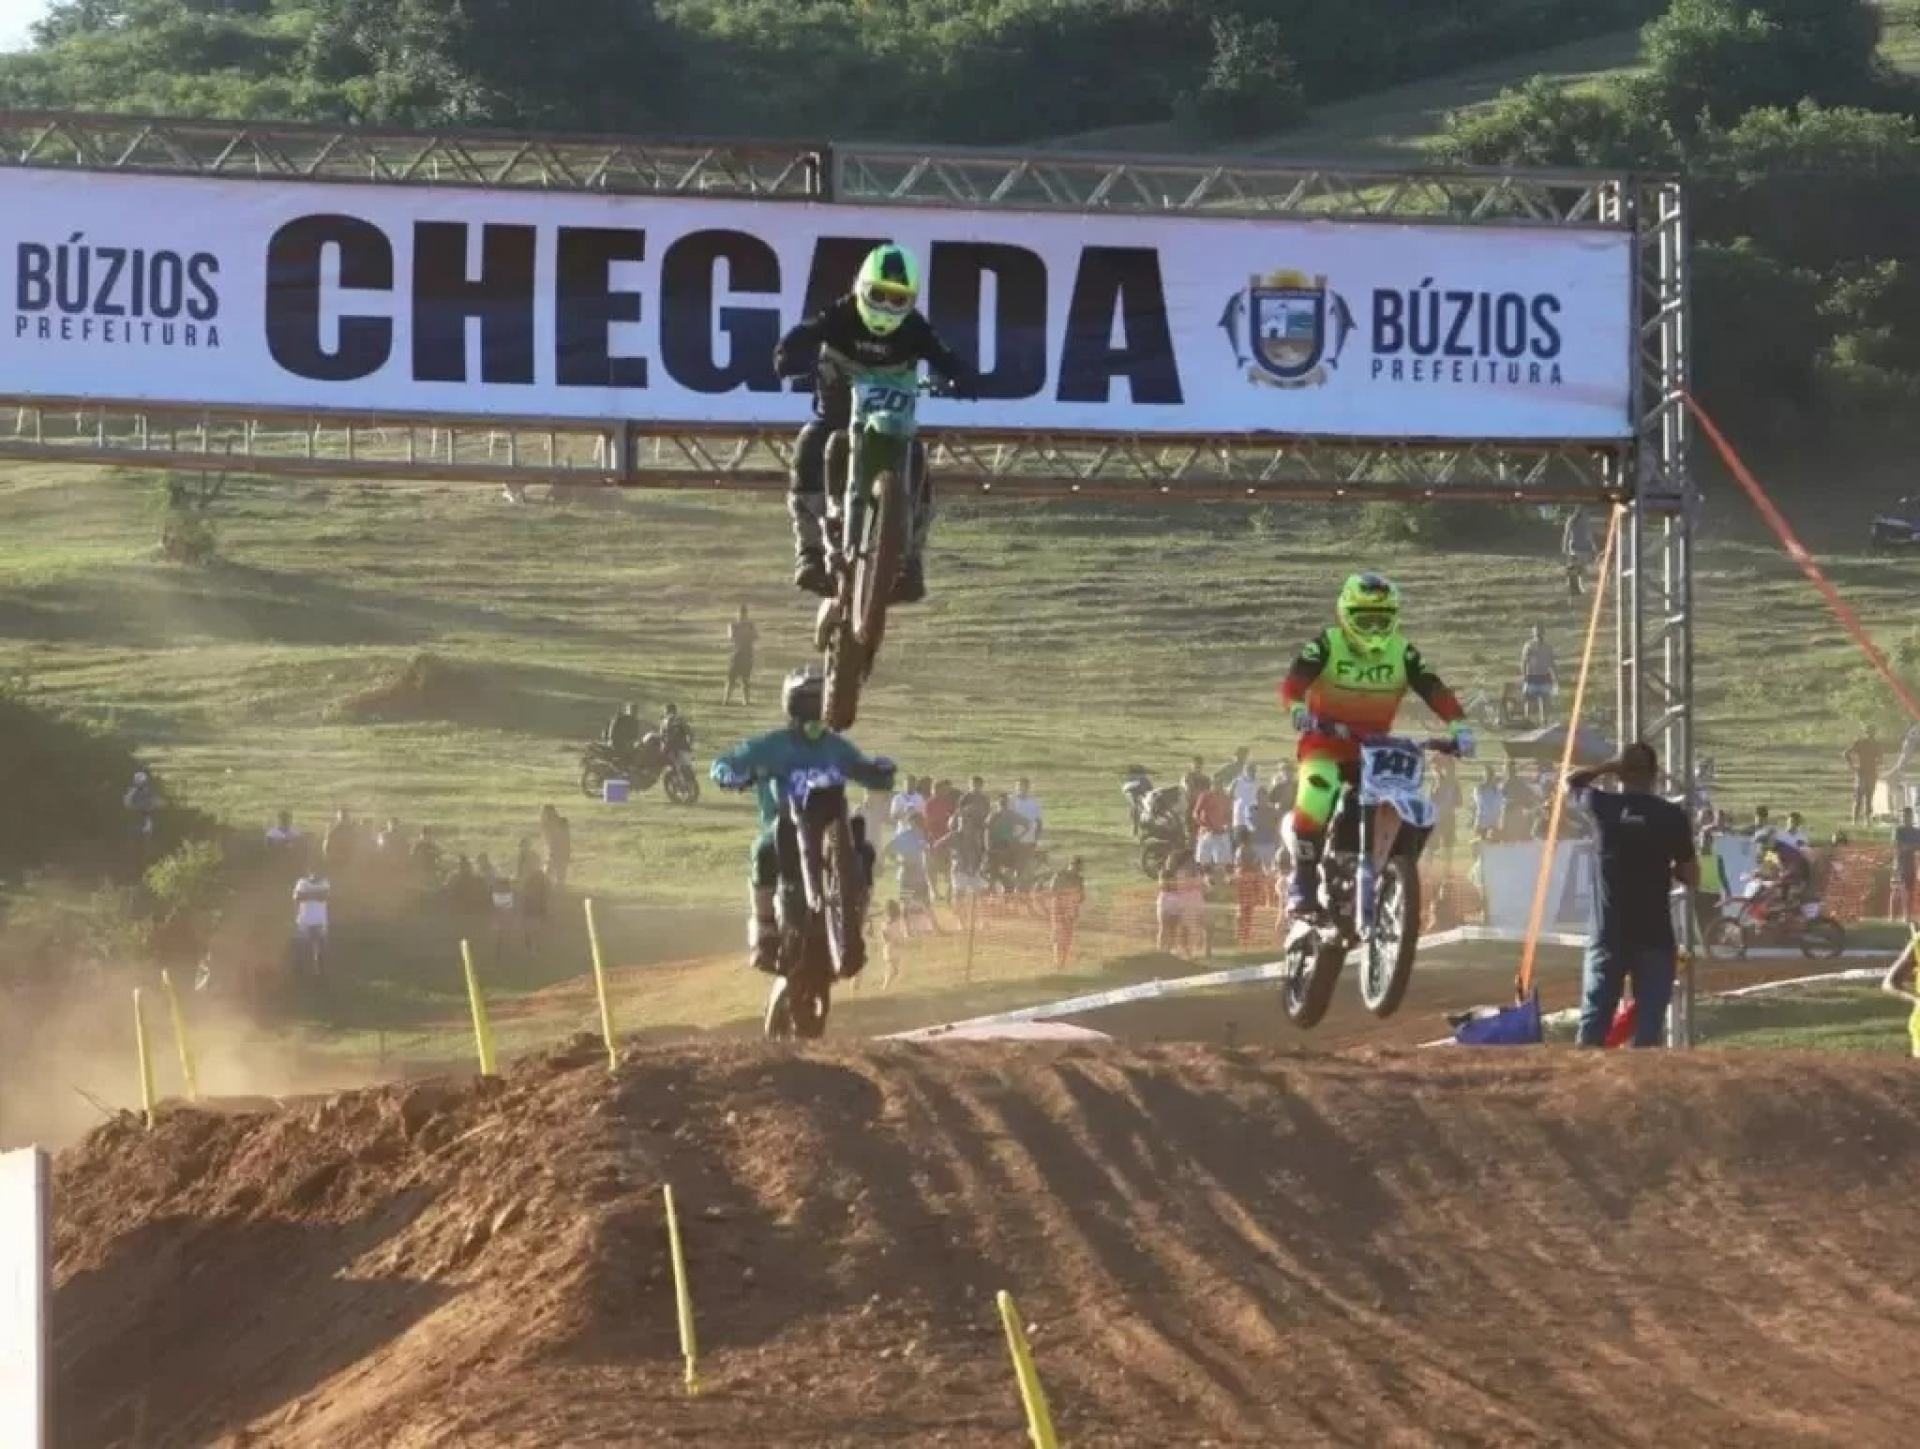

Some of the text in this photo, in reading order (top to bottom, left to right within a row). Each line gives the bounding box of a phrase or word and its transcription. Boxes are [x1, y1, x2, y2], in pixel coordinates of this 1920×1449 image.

[16, 231, 219, 320] BÚZIOS
[16, 316, 219, 347] PREFEITURA
[1371, 277, 1561, 358] BÚZIOS
[1371, 358, 1561, 384] PREFEITURA
[1336, 660, 1395, 682] FXR
